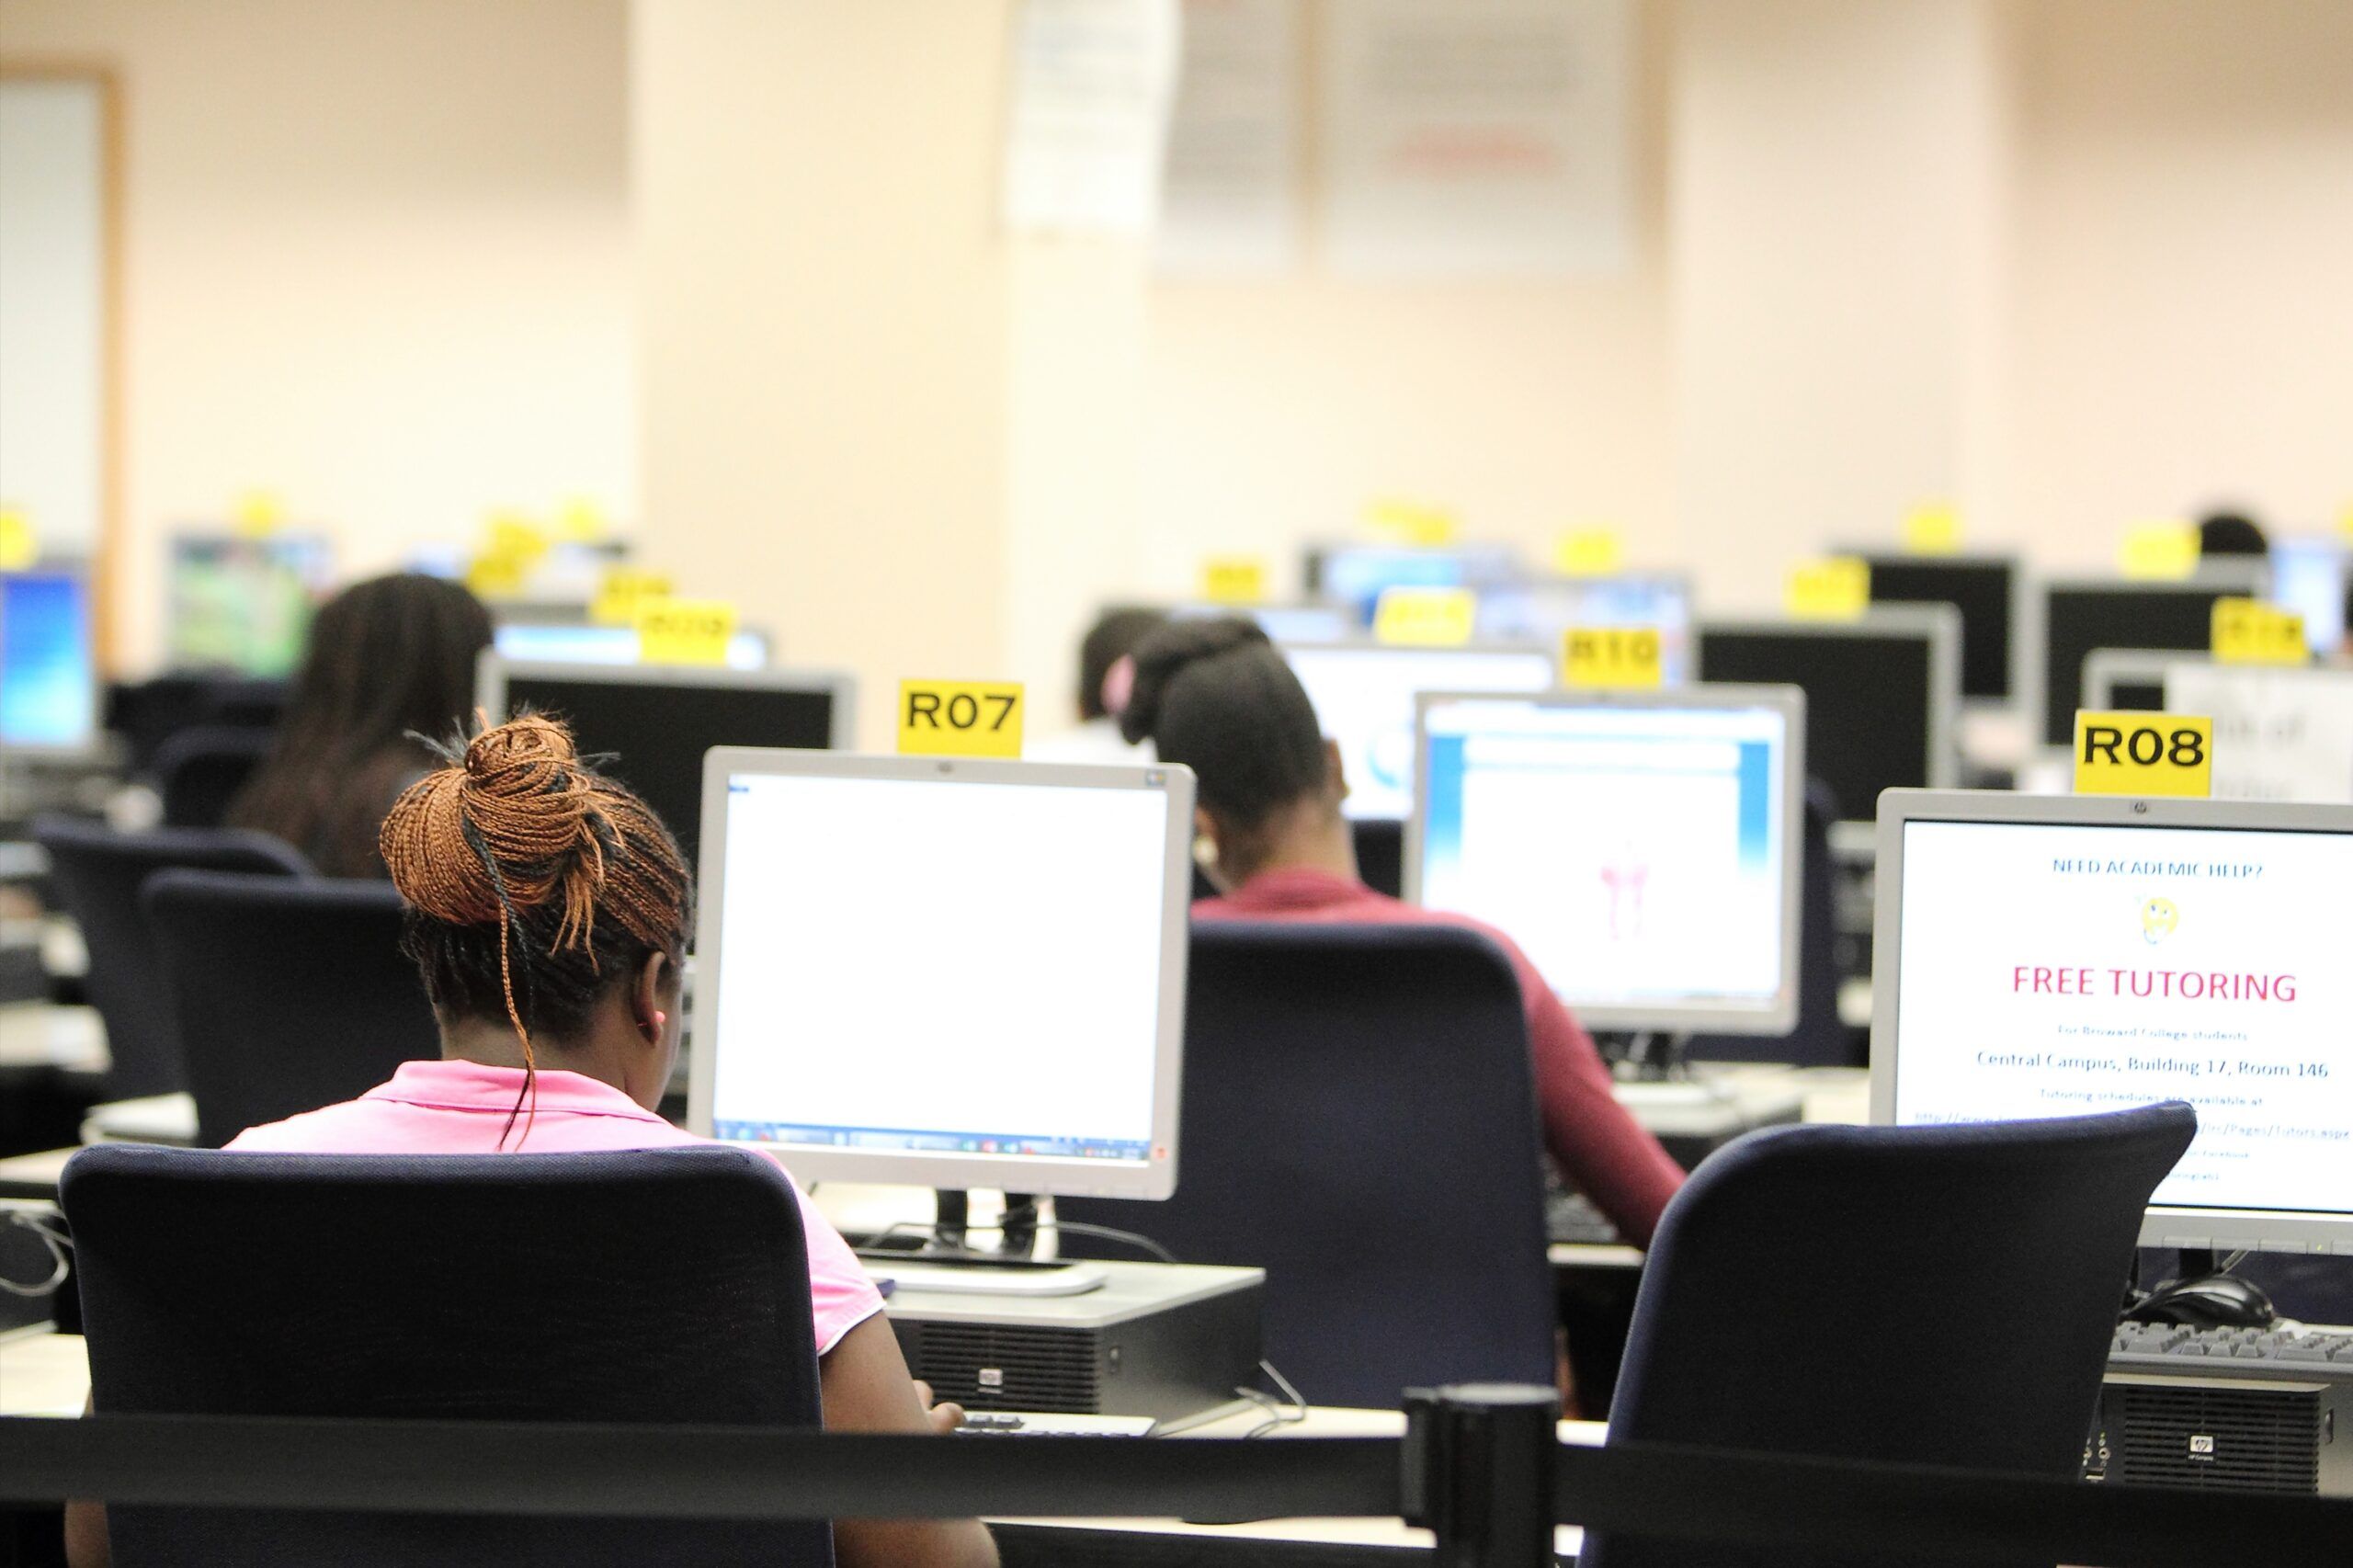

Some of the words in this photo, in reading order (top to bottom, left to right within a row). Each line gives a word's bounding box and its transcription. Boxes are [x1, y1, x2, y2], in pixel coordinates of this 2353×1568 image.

[908, 692, 1016, 731] R07
[2085, 726, 2204, 767] R08
[2052, 858, 2101, 874] NEED
[2106, 859, 2201, 877] ACADEMIC
[2209, 862, 2263, 879] HELP?
[2013, 965, 2095, 995] FREE
[2108, 969, 2296, 1003] TUTORING
[2058, 1025, 2077, 1035] For
[2142, 1028, 2188, 1041] College
[2193, 1030, 2248, 1040] students
[1977, 1051, 2040, 1067] Central
[2046, 1053, 2121, 1074] Campus,
[2128, 1055, 2200, 1076] Building
[2208, 1059, 2232, 1077] 17,
[2238, 1061, 2290, 1077] Room
[2298, 1062, 2329, 1079] 146
[2040, 1088, 2093, 1103] Tutoring
[2189, 1095, 2246, 1107] available
[2251, 1097, 2263, 1107] at
